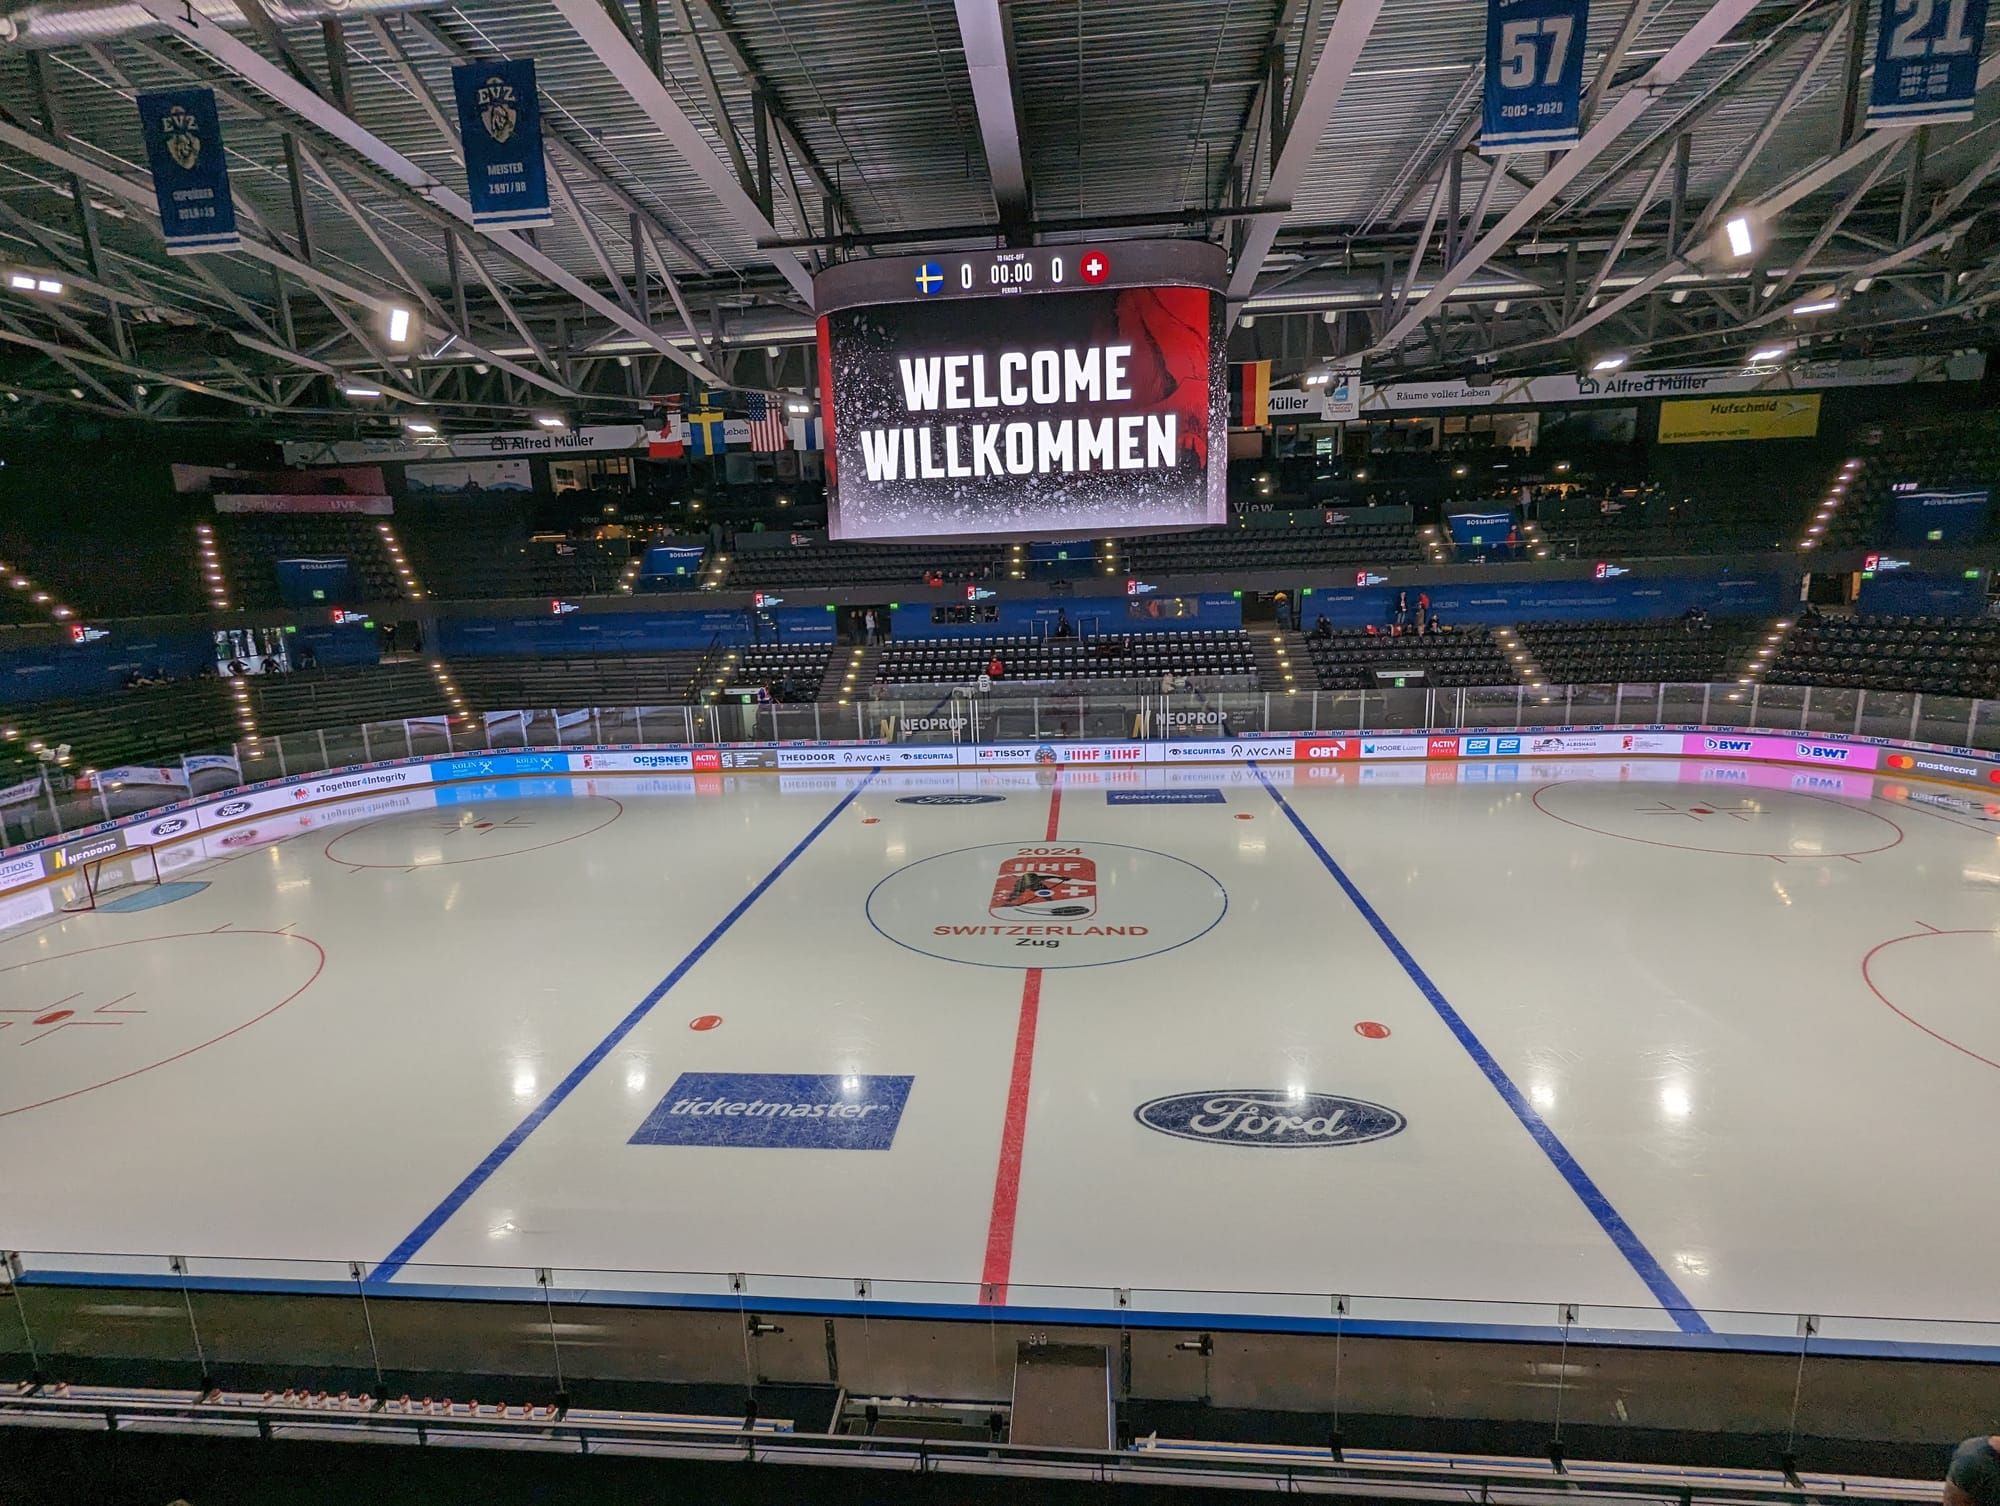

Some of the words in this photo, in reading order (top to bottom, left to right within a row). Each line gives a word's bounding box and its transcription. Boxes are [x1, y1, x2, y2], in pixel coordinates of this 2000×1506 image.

[1890, 0, 1975, 58] 21
[1500, 16, 1574, 89] 57
[478, 86, 516, 105] EVZ
[1501, 102, 1563, 118] 2003-2020
[487, 162, 523, 176] MEISTER
[961, 263, 972, 289] 0
[990, 262, 1033, 284] 00:00
[1052, 257, 1063, 283] 0
[900, 345, 1132, 412] WELCOME
[1604, 378, 1654, 394] Alfred
[1659, 375, 1708, 391] Müller
[1397, 390, 1429, 401] Räume
[1431, 389, 1458, 399] voller
[1461, 388, 1491, 398] Leben
[1711, 401, 1777, 415] Hufschmid
[511, 435, 551, 450] Alfred
[555, 434, 594, 448] Müller
[860, 414, 1176, 482] WILLKOMMEN
[1234, 502, 1274, 514] View
[900, 716, 968, 731] NEOPROP
[1156, 711, 1227, 726] NEOPROP
[1431, 740, 1457, 748] ACTIV
[1719, 741, 1751, 751] BWT
[780, 753, 835, 761] THEODOOR
[994, 749, 1031, 757] TISSOT
[1072, 750, 1100, 760] IIHF
[1112, 749, 1141, 760] IIHF
[1309, 747, 1340, 758] OBT
[1812, 747, 1848, 759] BWT
[1953, 747, 1973, 755] BWT
[452, 761, 477, 770] KOLIN
[516, 757, 538, 765] KOLIN
[633, 755, 689, 764] OCHSNER
[347, 764, 363, 772] BWT
[1916, 761, 1977, 776] mastercard
[316, 773, 406, 793] #Together4Integrity
[917, 794, 982, 804] Ford
[1114, 792, 1210, 801] ticketmaster
[164, 803, 180, 812] BWT
[222, 803, 247, 816] Ford
[134, 812, 150, 821] BWT
[100, 820, 118, 830] BWT
[158, 821, 184, 835] Ford
[25, 840, 46, 850] BWT
[1017, 848, 1082, 856] 2024
[1015, 863, 1081, 872] IIHF
[933, 926, 1149, 936] SWITZERLAND
[1015, 938, 1060, 948] Zug
[669, 1096, 878, 1118] ticketmaster
[1190, 1097, 1348, 1136] Ford
